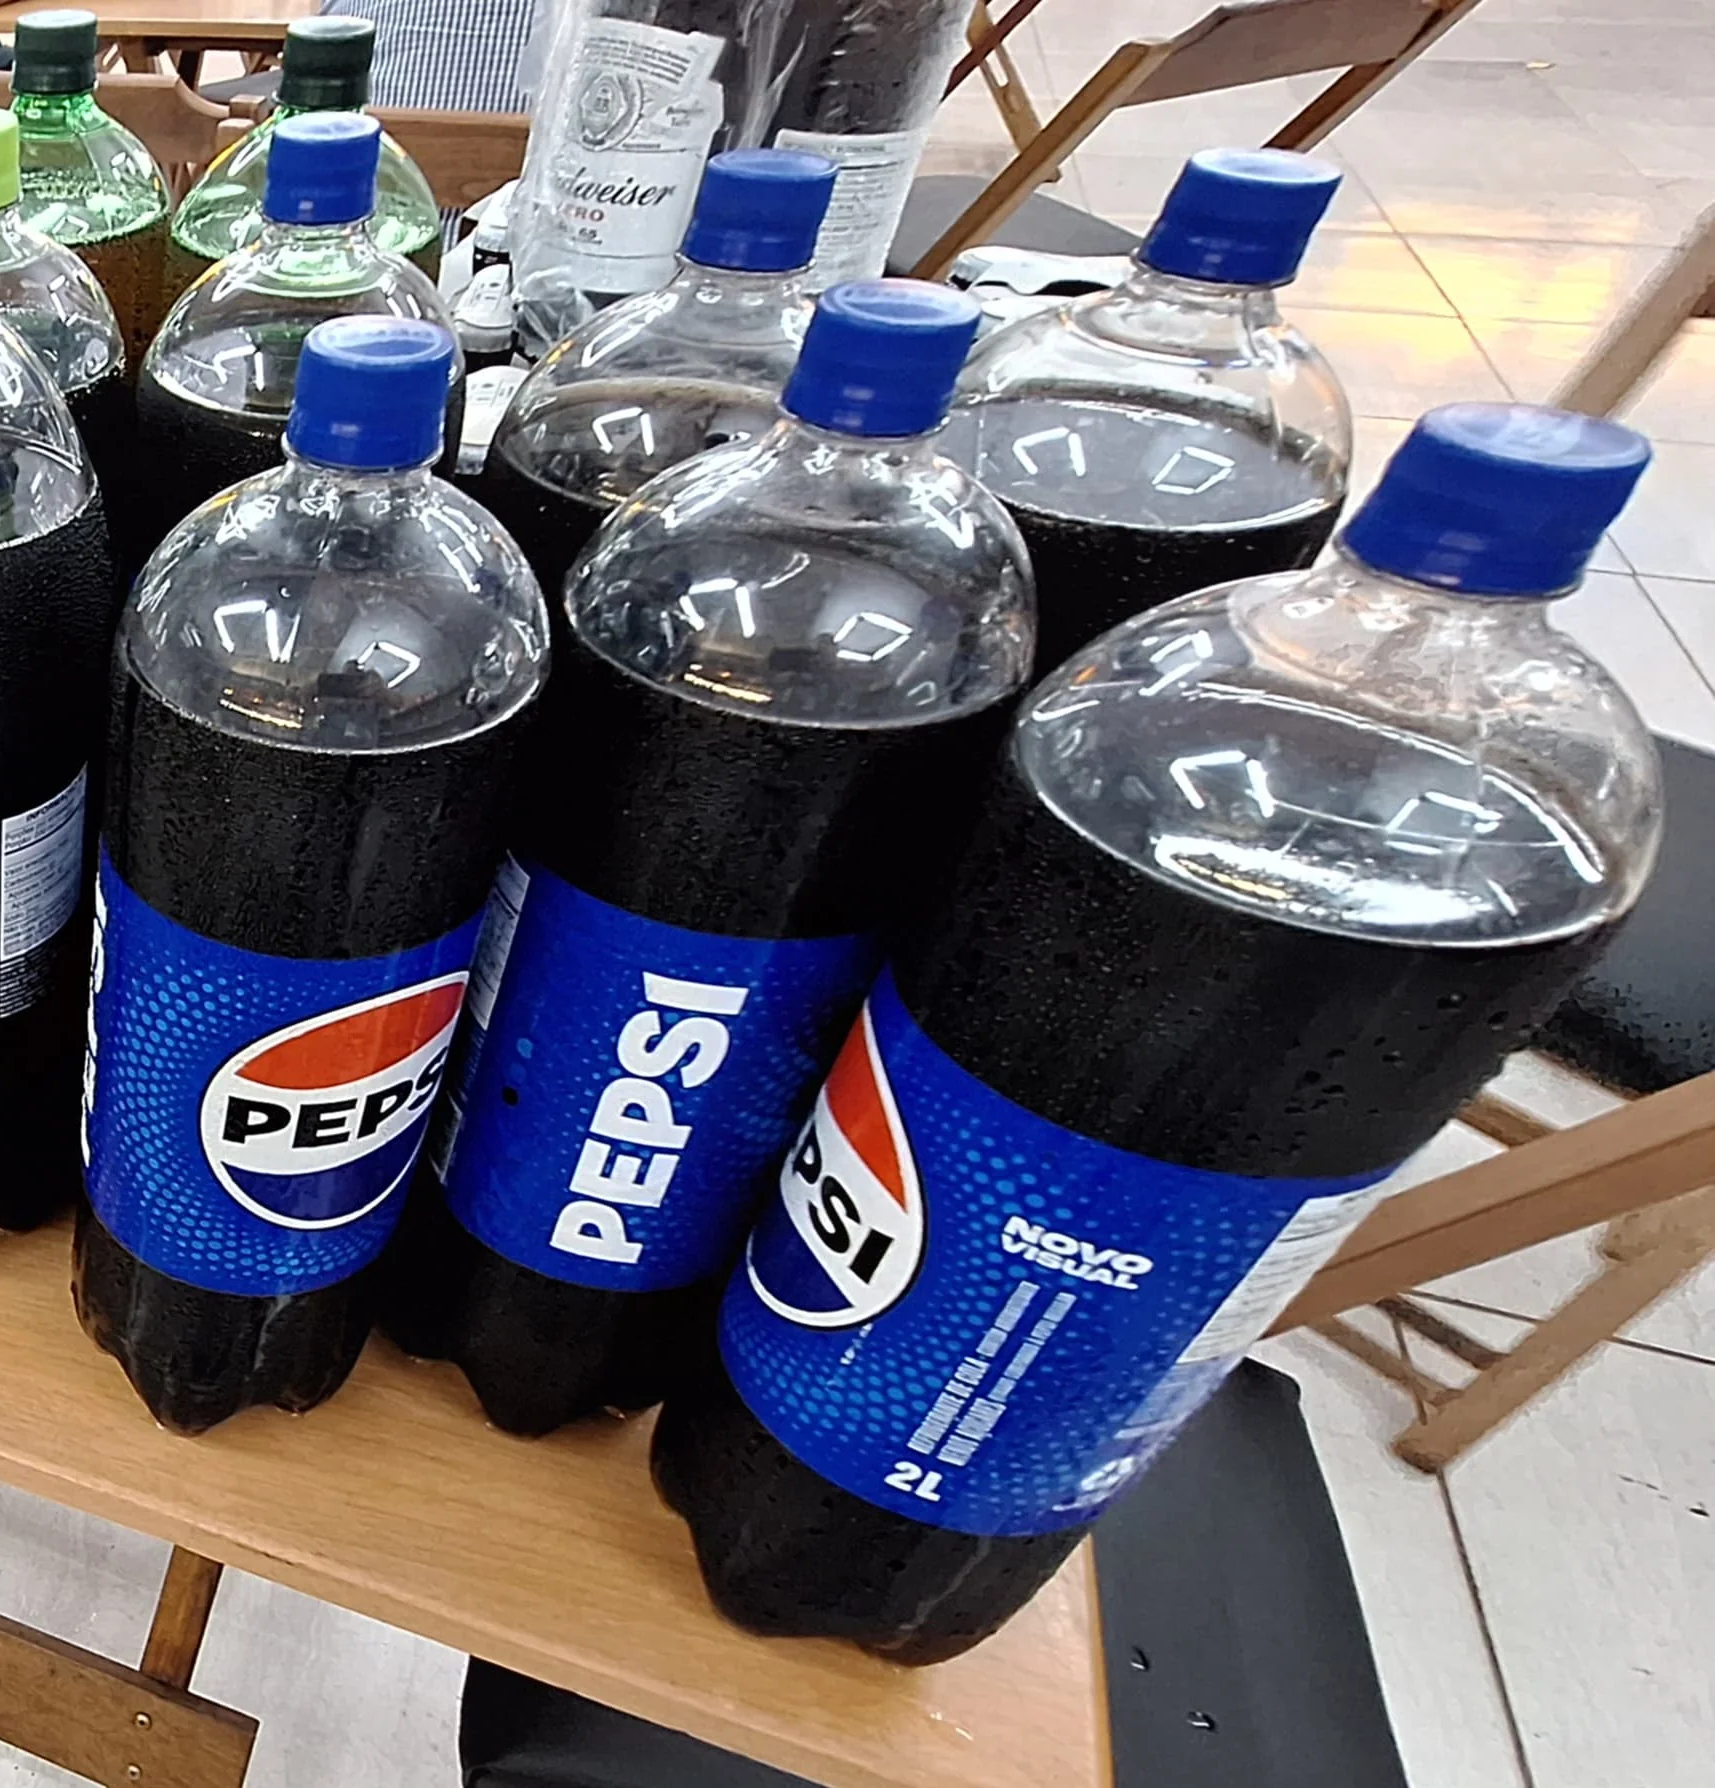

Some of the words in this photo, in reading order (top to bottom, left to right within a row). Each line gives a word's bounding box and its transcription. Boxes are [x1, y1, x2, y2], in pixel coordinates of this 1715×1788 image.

[559, 167, 677, 206] dweiser
[222, 1046, 449, 1149] PEPS
[549, 971, 750, 1265] PEPSI
[792, 1112, 895, 1285] PSI
[1000, 1234, 1139, 1290] VISUAL
[1003, 1215, 1154, 1277] NOVO
[884, 1461, 943, 1502] 2L
